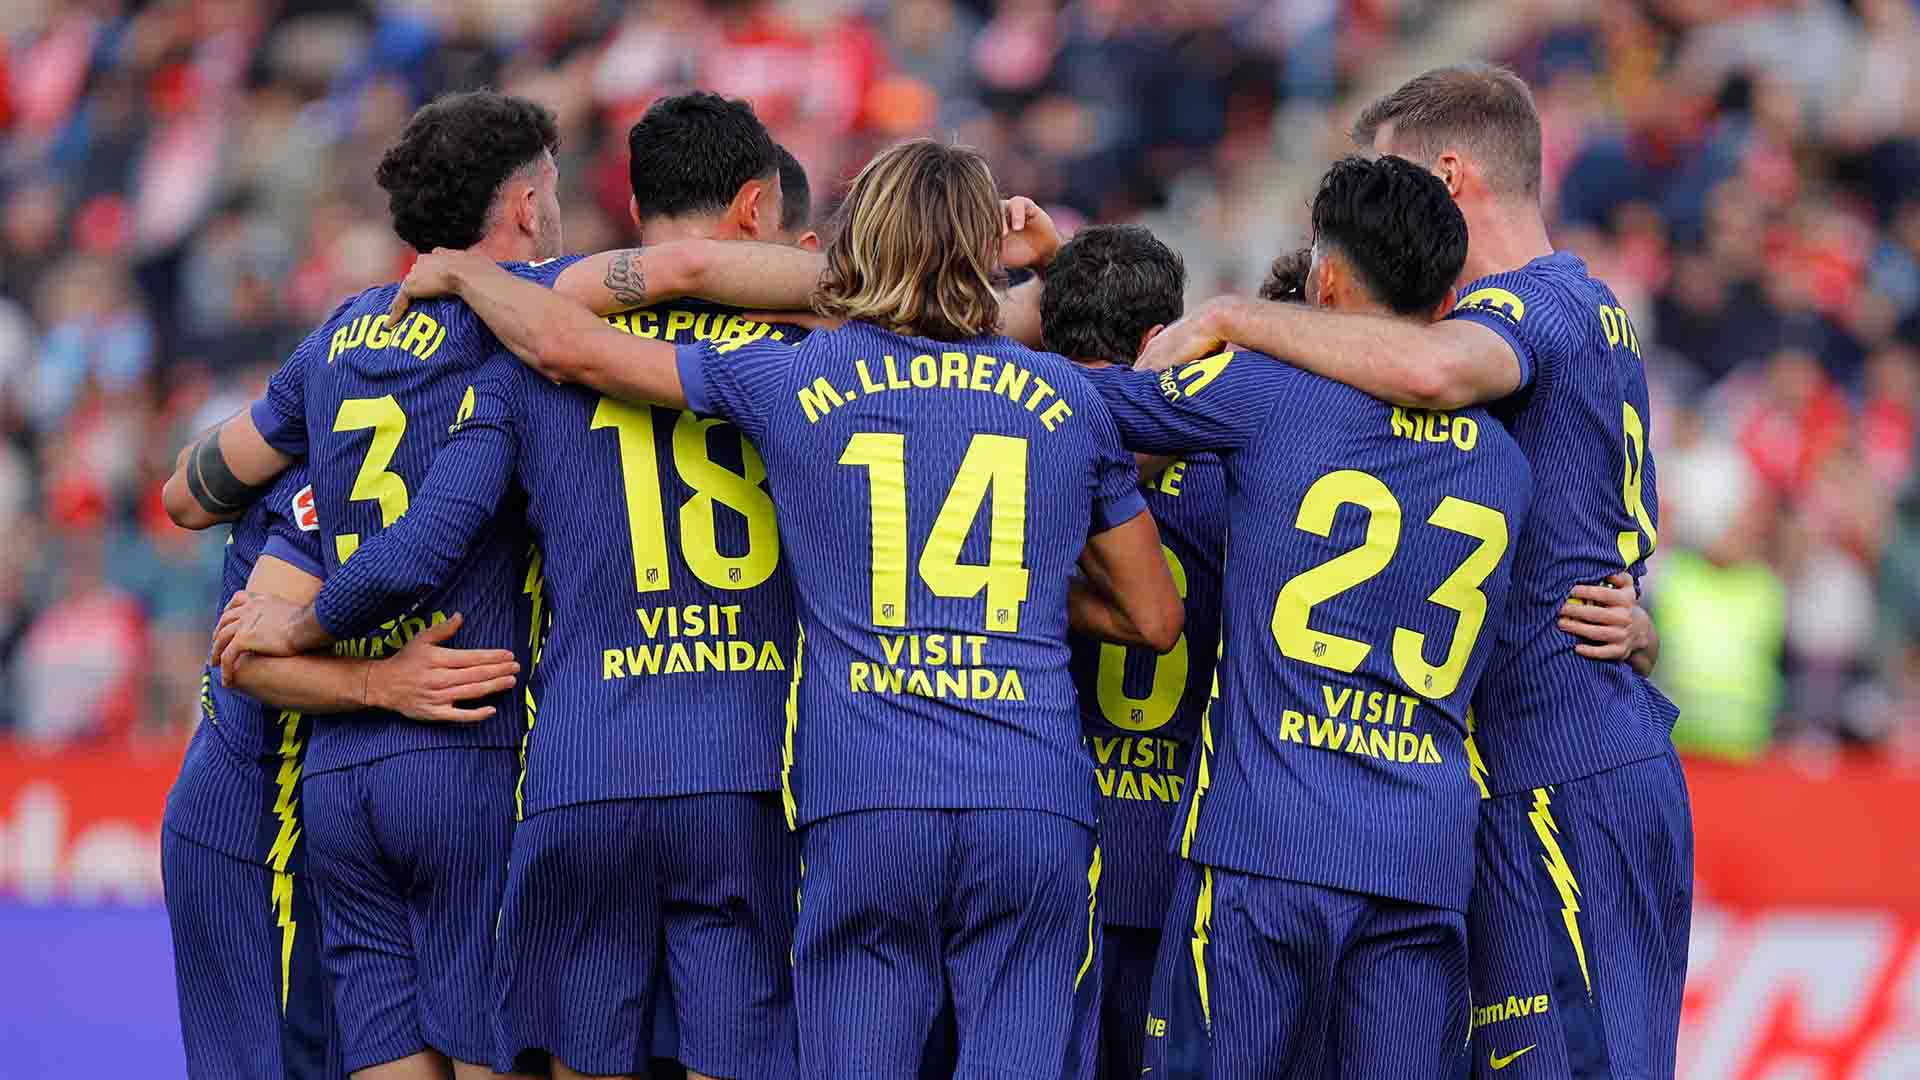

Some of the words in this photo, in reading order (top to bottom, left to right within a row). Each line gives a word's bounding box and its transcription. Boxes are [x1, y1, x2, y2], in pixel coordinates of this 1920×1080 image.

[1390, 406, 1479, 451] NICO
[332, 394, 409, 566] 3
[589, 397, 780, 594] 18
[1616, 400, 1657, 568] 9
[837, 431, 1030, 632] 14
[1269, 468, 1509, 700] 23
[635, 603, 743, 638] VISIT
[602, 640, 786, 680] RWANDA
[878, 633, 988, 666] VISIT
[849, 661, 1026, 701] RWANDA
[1321, 684, 1420, 727] VISIT
[1092, 736, 1179, 771] VISIT
[1278, 709, 1443, 764] RWANDA
